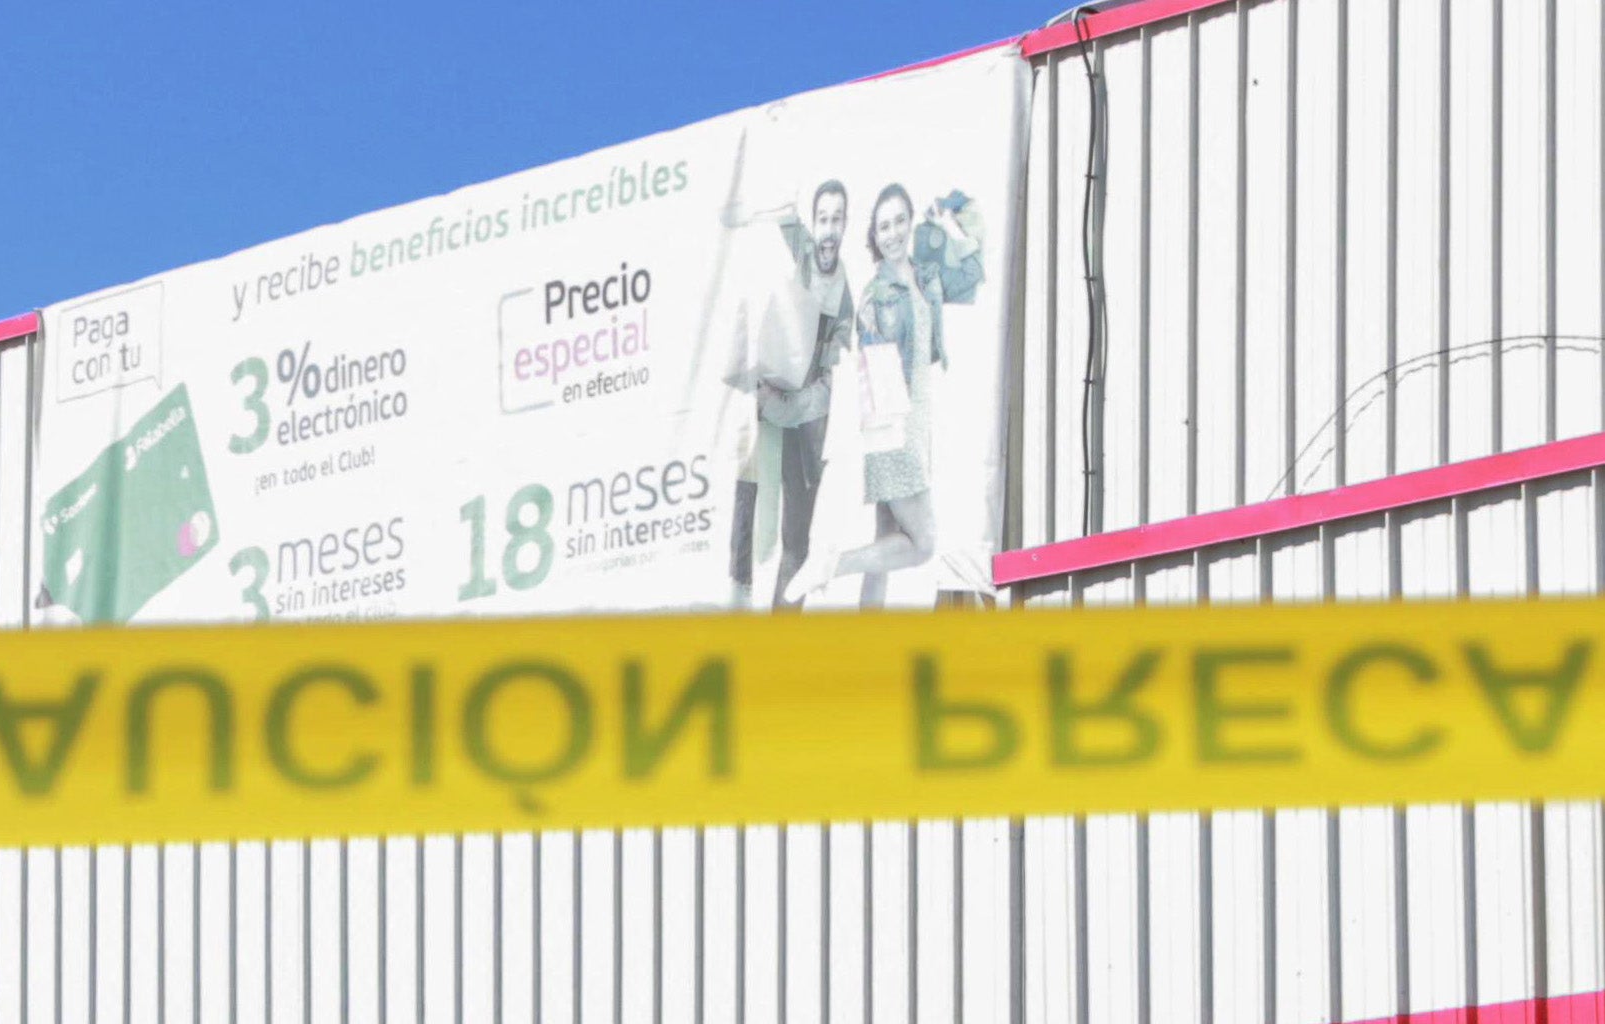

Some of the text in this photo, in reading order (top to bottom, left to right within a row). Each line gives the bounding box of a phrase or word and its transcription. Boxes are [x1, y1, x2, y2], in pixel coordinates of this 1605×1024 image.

[231, 158, 689, 322] y recibe beneficios increíbles
[545, 261, 651, 325] Precio
[73, 310, 130, 351] Paga
[514, 308, 650, 385] especial
[71, 343, 142, 385] con tu
[324, 348, 407, 395] dinero
[562, 366, 650, 404] en efectivo
[276, 391, 408, 447] electrónico
[283, 461, 317, 486] todo
[321, 455, 334, 476] el
[338, 446, 376, 474] Club!
[457, 454, 710, 602] 18 meses
[566, 528, 596, 559] sin
[228, 517, 405, 622] 3 meses
[275, 568, 406, 614] sin intereses
